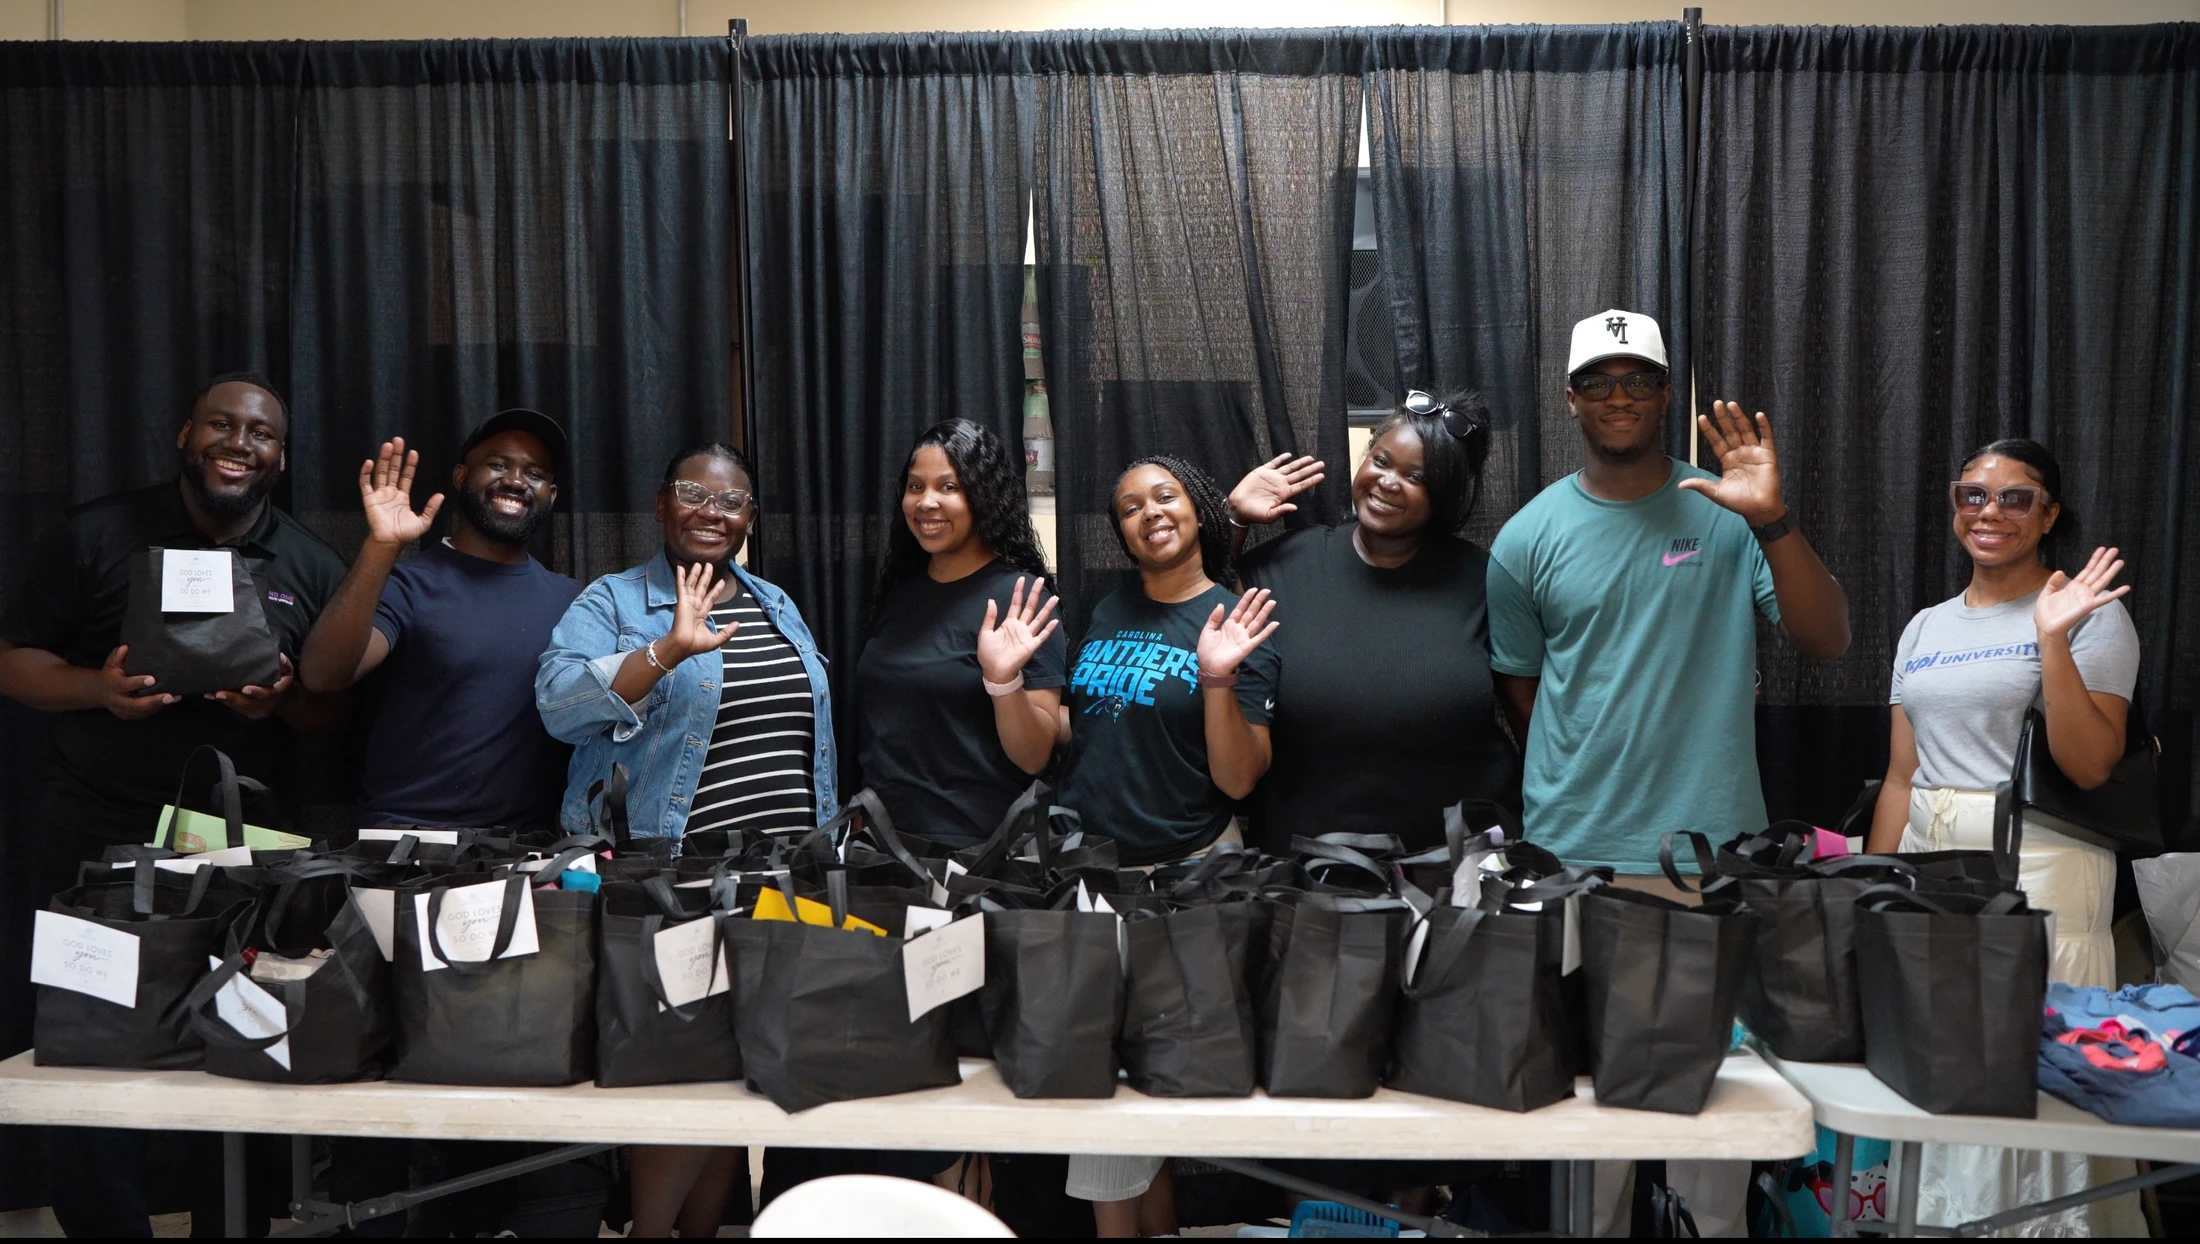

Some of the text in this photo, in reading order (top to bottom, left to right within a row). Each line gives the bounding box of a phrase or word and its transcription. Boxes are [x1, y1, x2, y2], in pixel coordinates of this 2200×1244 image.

[1671, 537, 1702, 552] NIKE
[1116, 630, 1163, 641] CAROLINA
[1071, 662, 1166, 706] PRIDE
